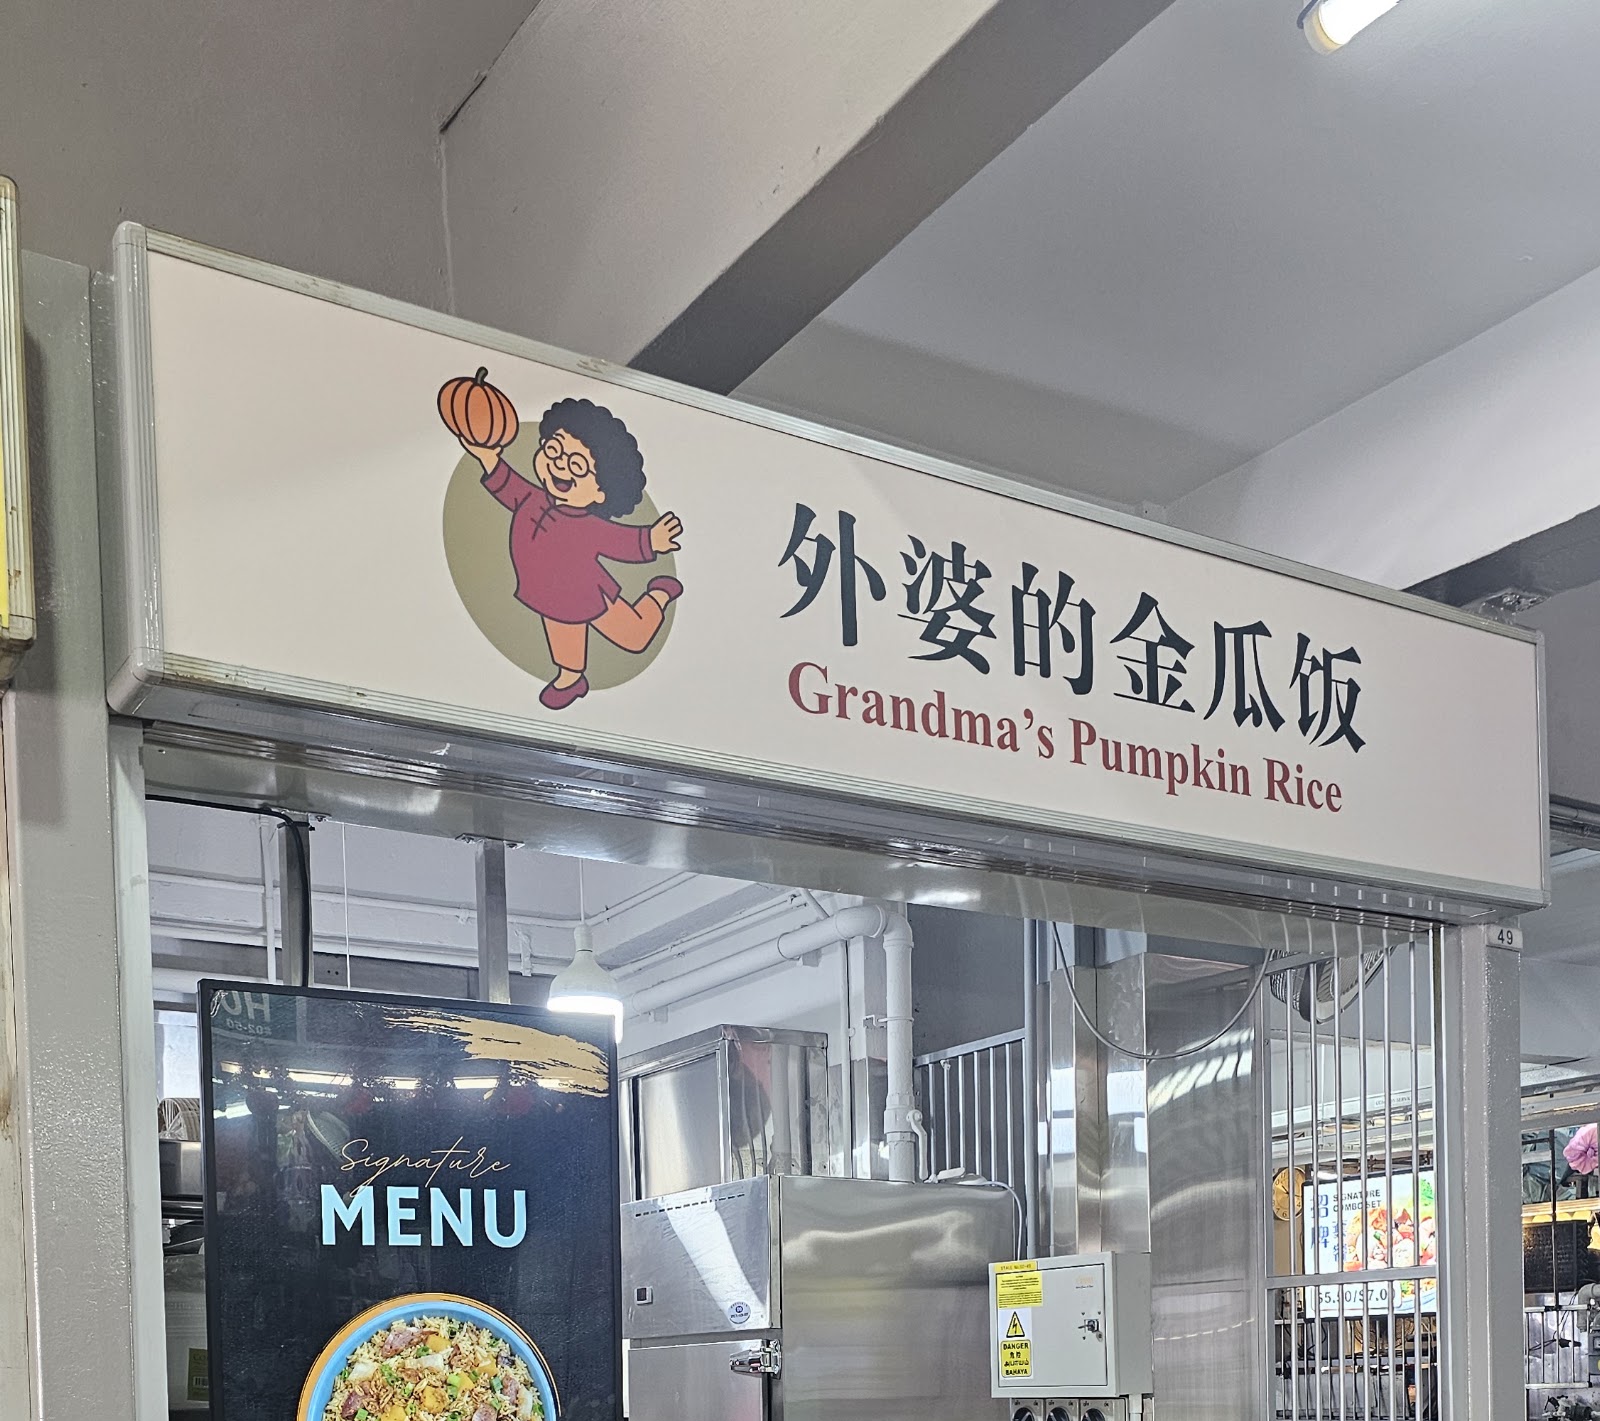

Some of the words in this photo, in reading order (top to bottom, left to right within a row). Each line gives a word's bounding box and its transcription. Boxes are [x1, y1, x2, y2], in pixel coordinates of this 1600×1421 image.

[777, 502, 1367, 754] 外婆的金瓜饭
[787, 661, 1055, 760] Grandma's
[1069, 717, 1252, 798] Pumpkin
[1262, 757, 1344, 814] Rice
[1497, 929, 1514, 946] 49
[340, 1136, 512, 1198] Signature
[320, 1183, 528, 1249] MENU
[1003, 1342, 1029, 1350] DANGER
[1005, 1368, 1028, 1376] BAHAYA
